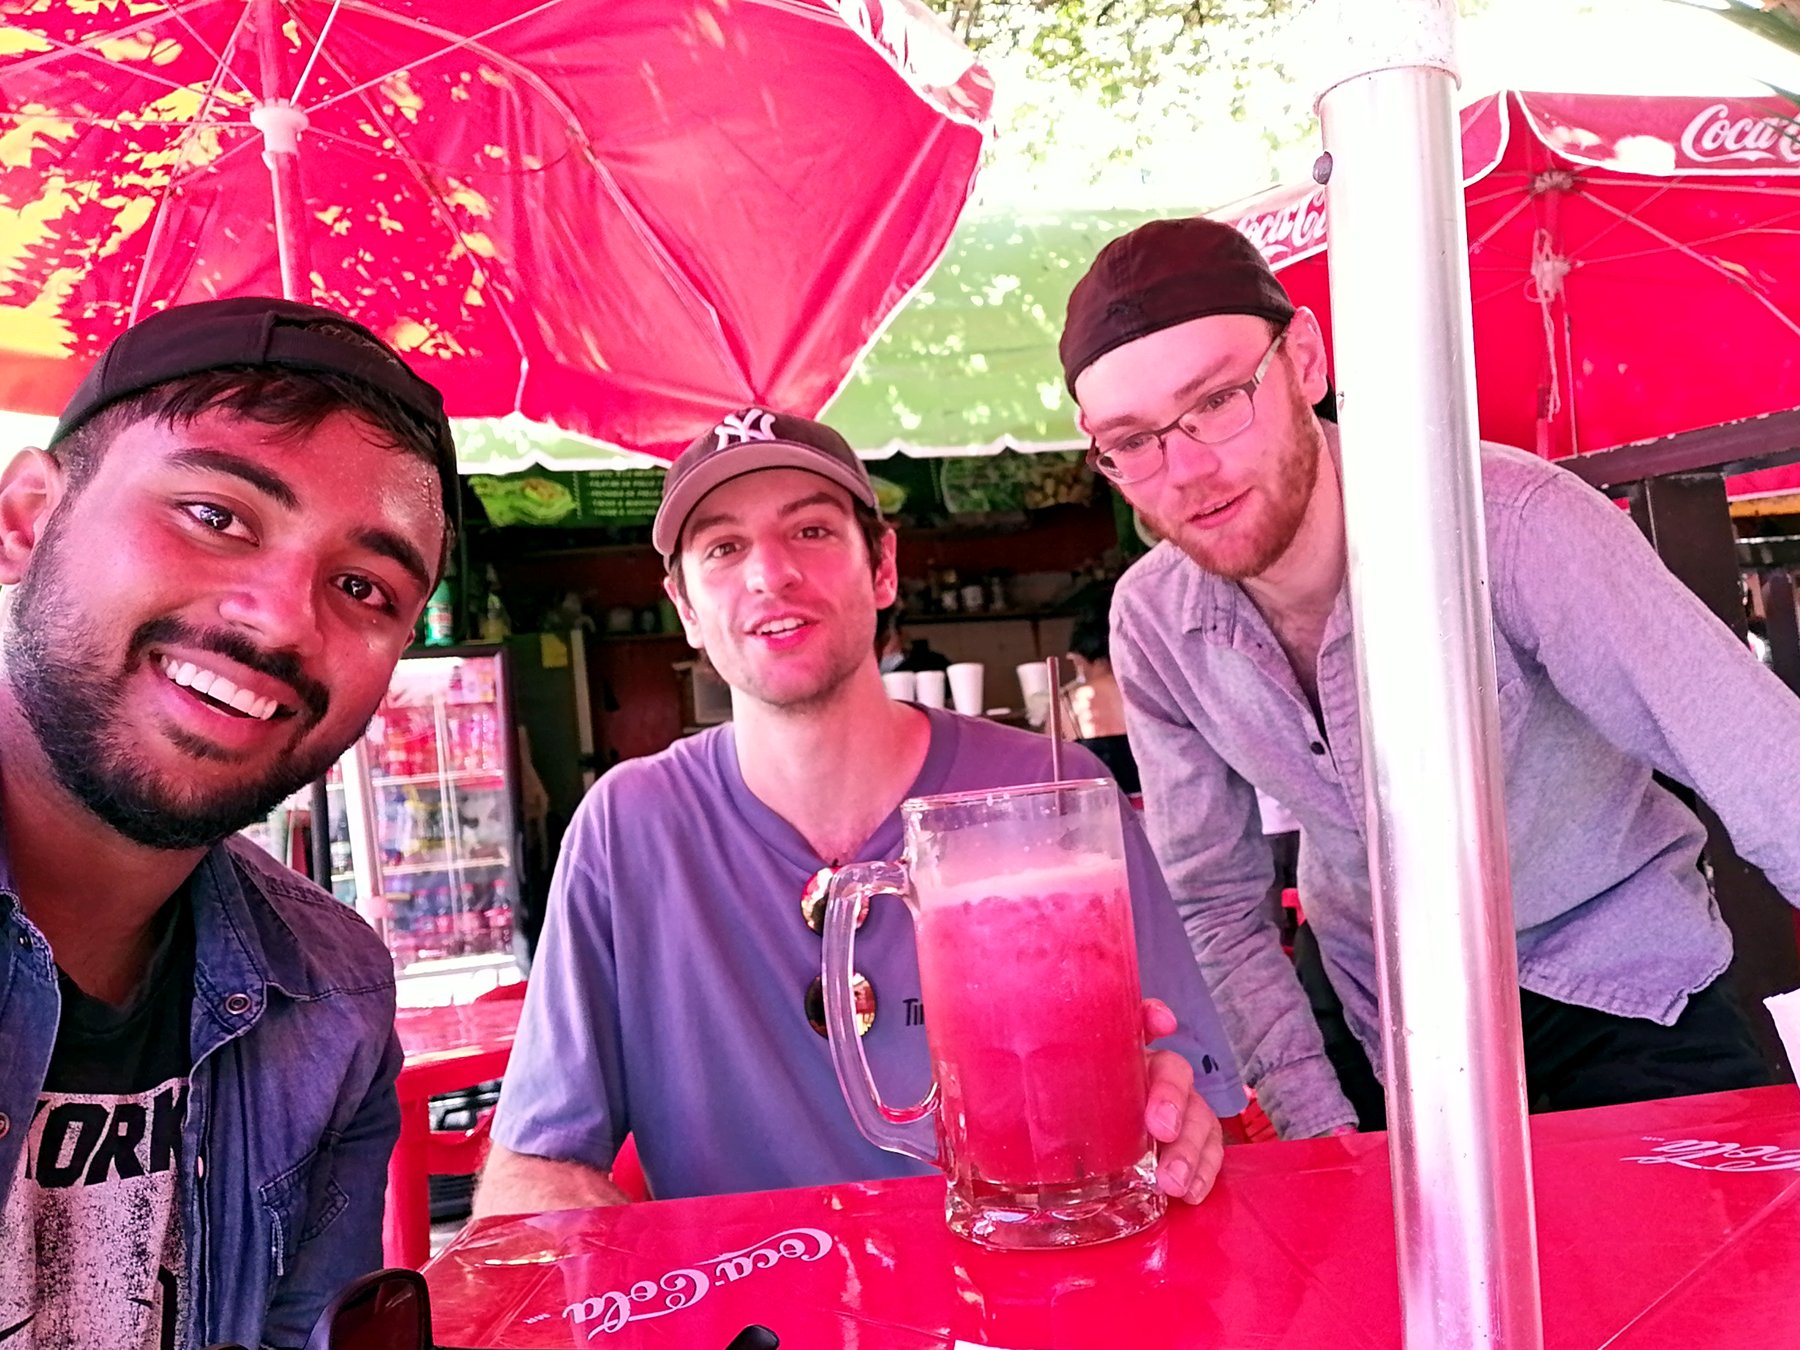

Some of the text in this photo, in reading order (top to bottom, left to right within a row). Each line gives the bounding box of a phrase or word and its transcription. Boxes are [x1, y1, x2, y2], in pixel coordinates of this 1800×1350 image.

[714, 408, 776, 451] NY
[26, 1084, 189, 1188] ORK
[562, 1227, 833, 1341] Coca-Cola
